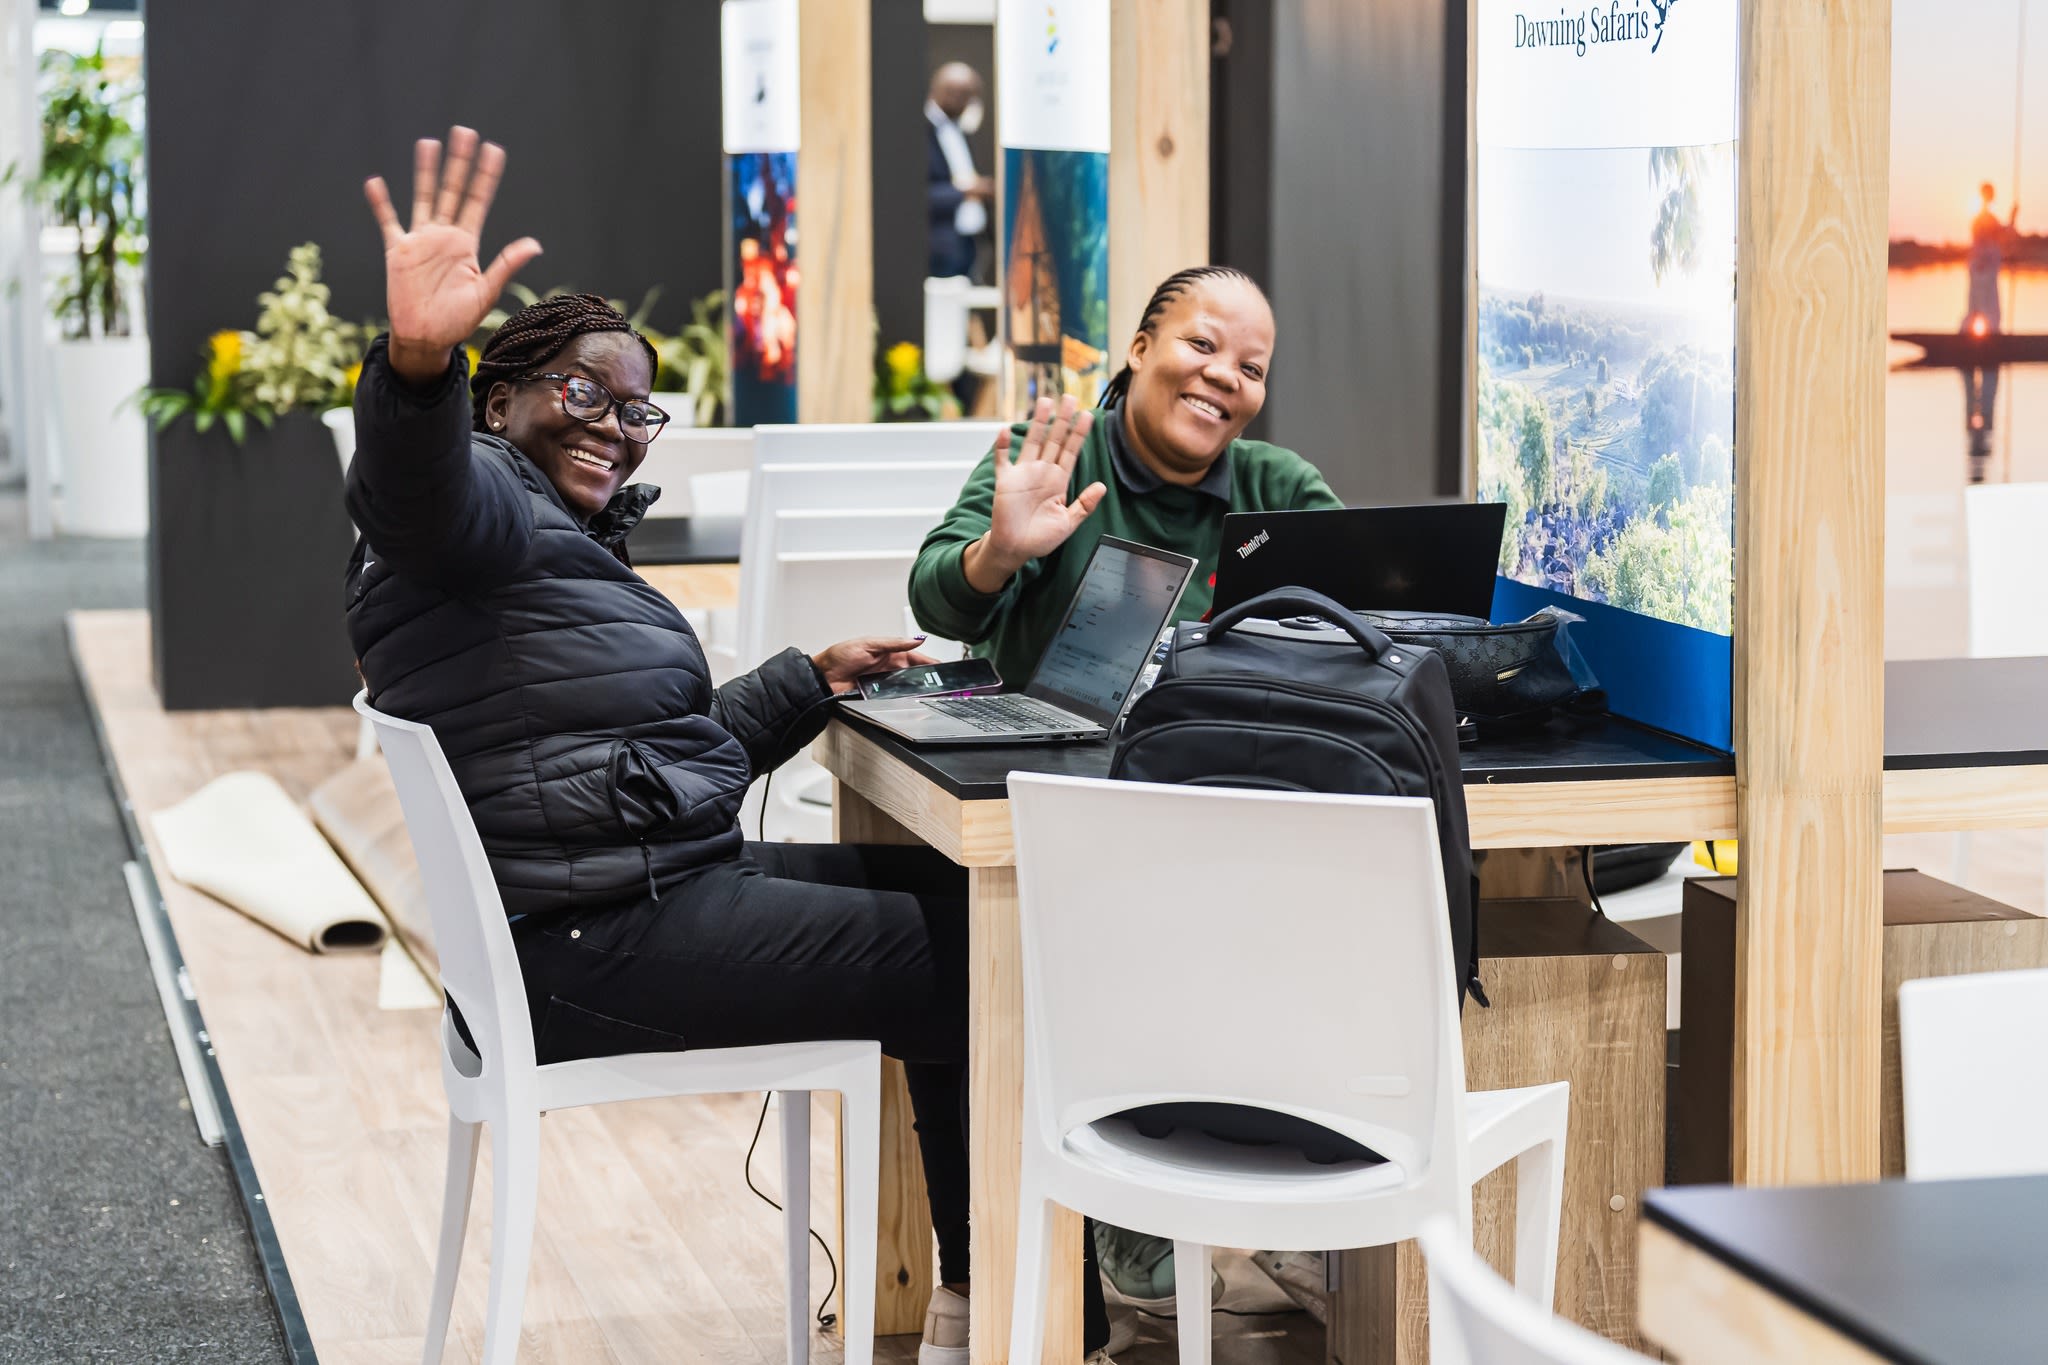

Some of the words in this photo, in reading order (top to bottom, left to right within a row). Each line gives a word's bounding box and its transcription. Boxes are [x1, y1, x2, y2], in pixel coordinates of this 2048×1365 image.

[1515, 8, 1586, 57] Dawning
[1591, 0, 1649, 44] Safaris
[1236, 529, 1270, 560] ThinkPad
